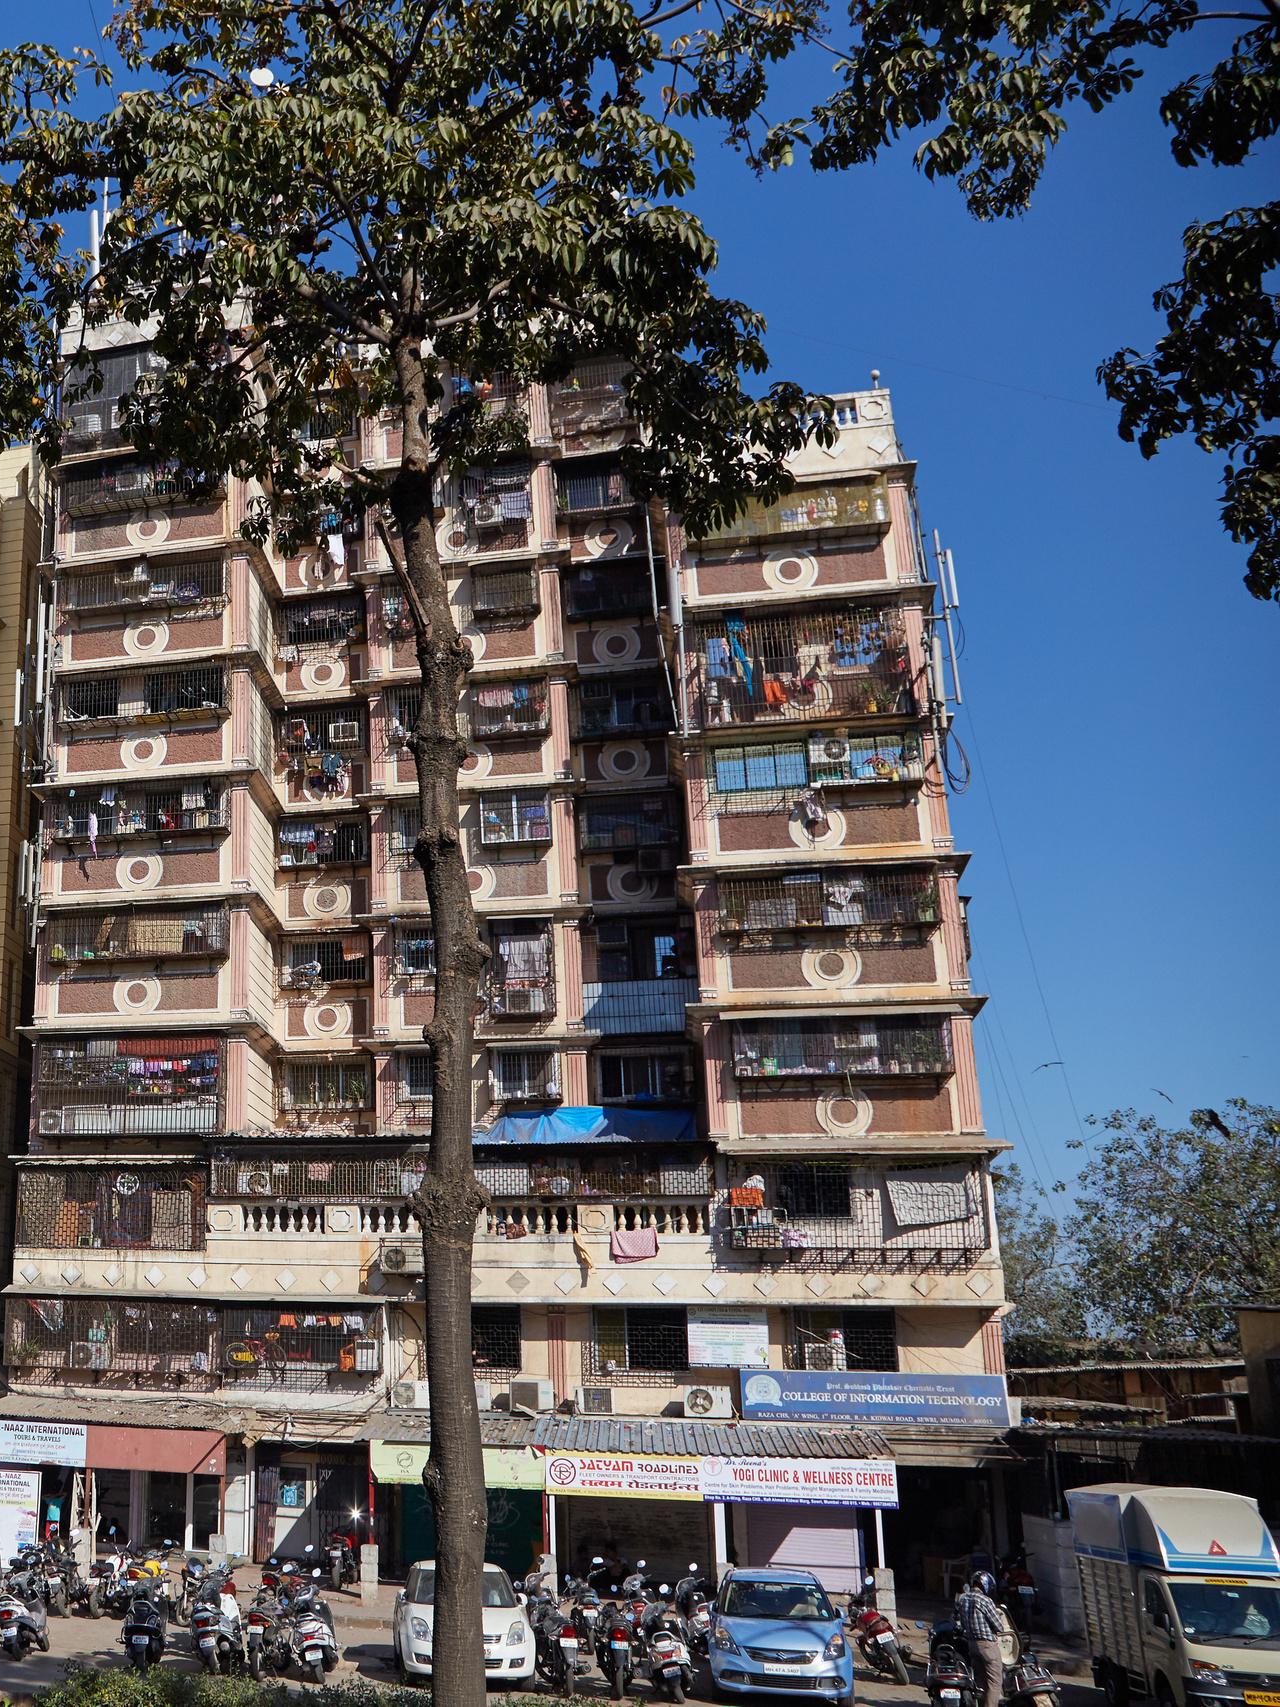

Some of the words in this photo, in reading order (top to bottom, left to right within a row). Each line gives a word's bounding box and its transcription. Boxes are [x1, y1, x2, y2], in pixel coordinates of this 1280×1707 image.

[782, 1391, 832, 1402] COLLEGE
[833, 1392, 848, 1402] OF
[849, 1393, 925, 1404] INFORMATION
[926, 1395, 1002, 1407] TECHNOLOGY
[26, 1425, 85, 1436] INTERNATIONAL
[579, 1459, 634, 1472] SATYAM
[724, 1458, 736, 1466] Dr.
[738, 1458, 766, 1466] Reena's
[732, 1468, 755, 1482] YOGI
[758, 1469, 789, 1483] CLINIC
[792, 1470, 800, 1483] &
[802, 1470, 853, 1486] WELLNESS
[856, 1472, 894, 1486] CENTRE
